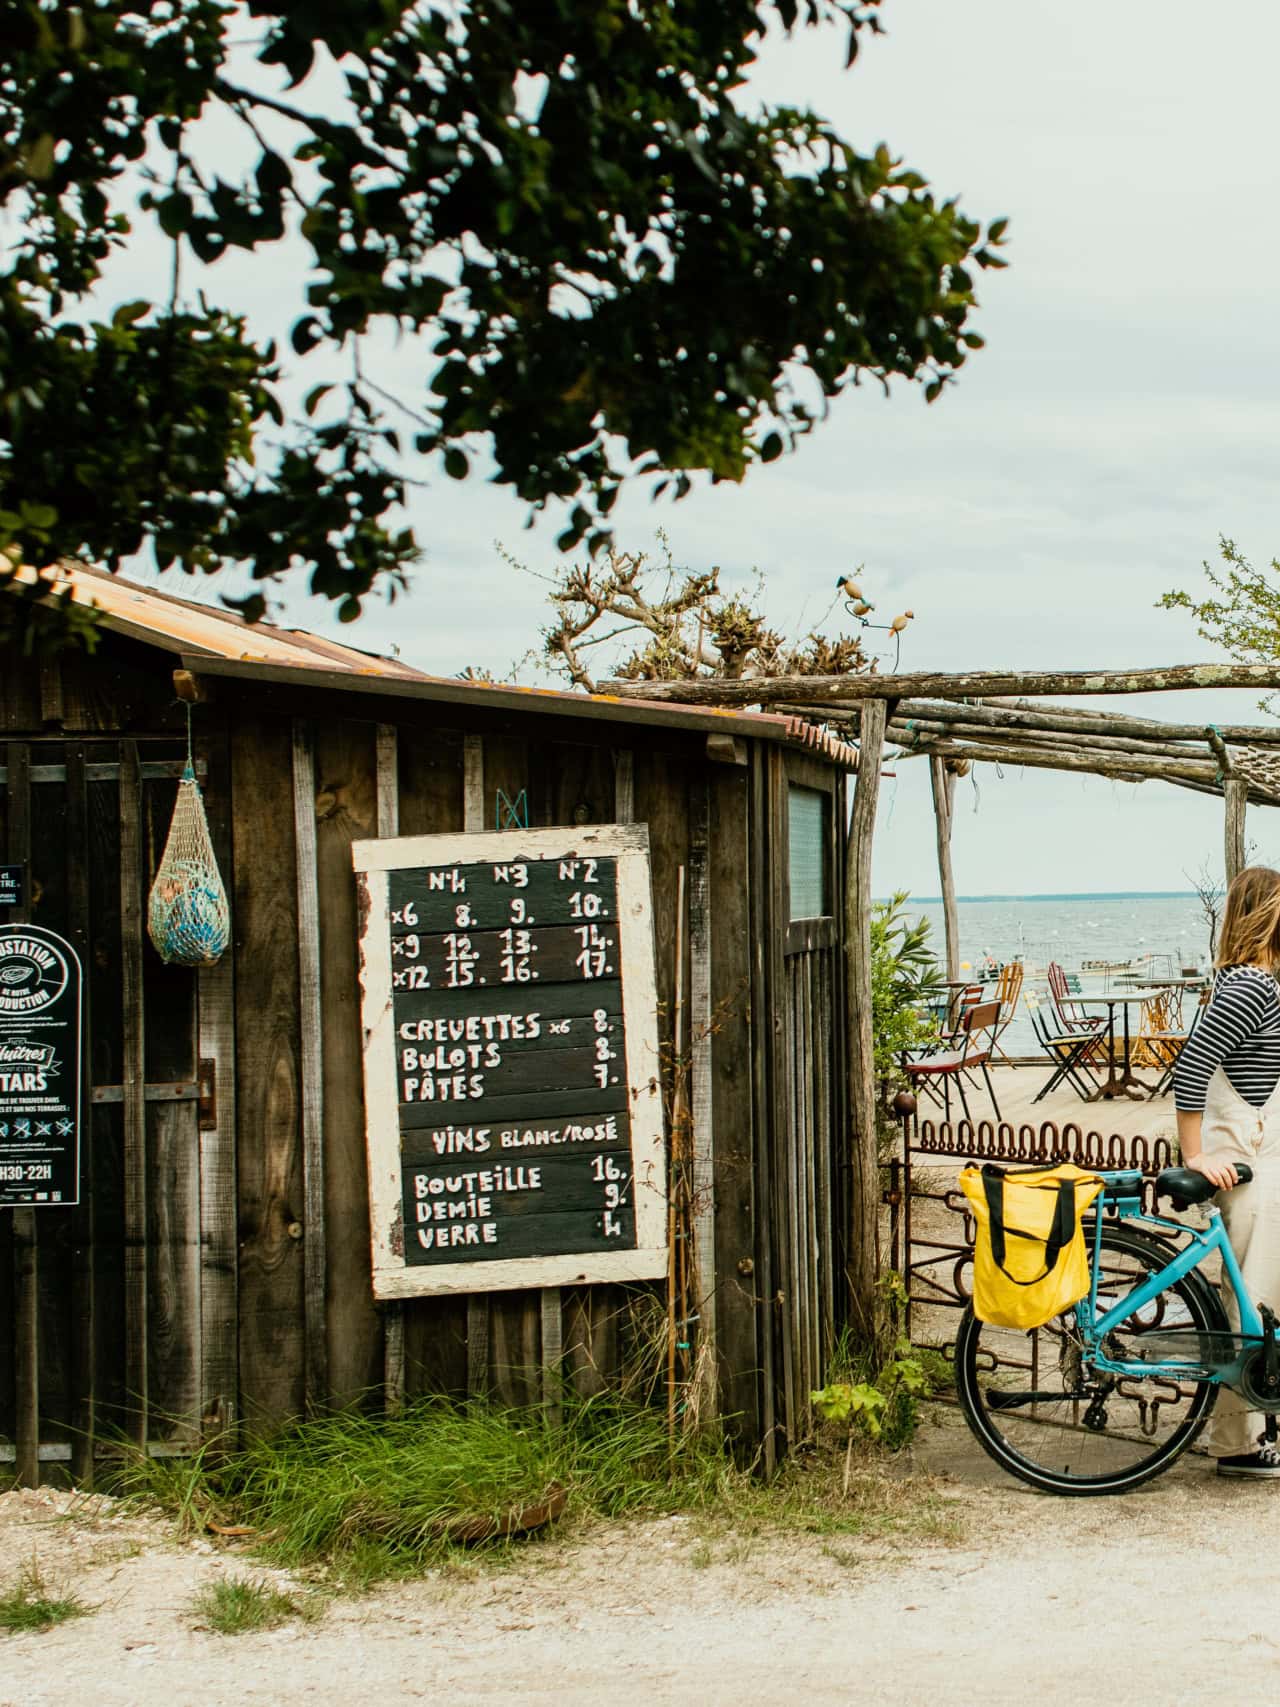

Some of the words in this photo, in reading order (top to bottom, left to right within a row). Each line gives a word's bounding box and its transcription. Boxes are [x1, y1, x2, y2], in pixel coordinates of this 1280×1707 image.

[399, 1012, 541, 1042] CREVETTES
[404, 1068, 485, 1102] PÂTÉS
[417, 1222, 498, 1249] VERRE
